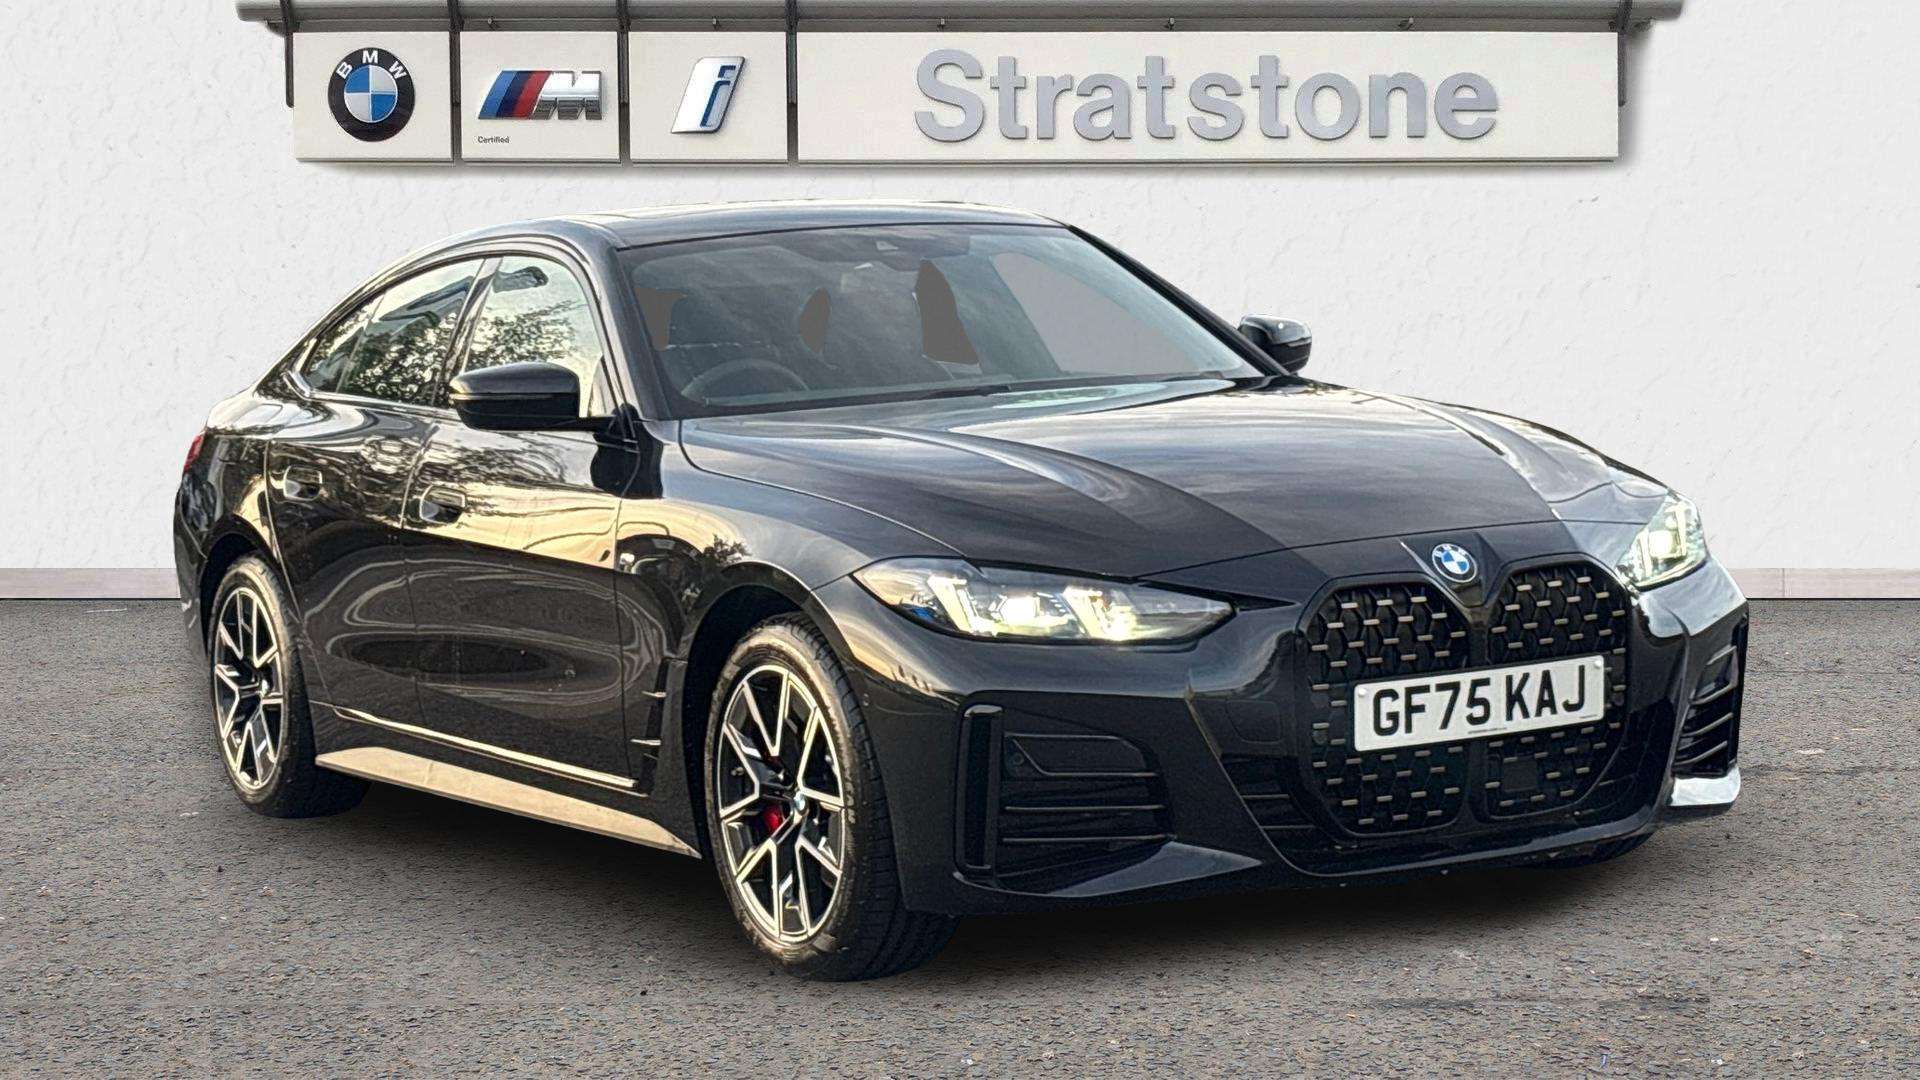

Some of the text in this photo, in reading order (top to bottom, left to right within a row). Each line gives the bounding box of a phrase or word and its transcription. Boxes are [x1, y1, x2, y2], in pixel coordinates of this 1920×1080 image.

[336, 50, 407, 80] BMW
[914, 48, 1500, 143] Stratstone
[477, 136, 510, 144] Certified
[1372, 664, 1586, 737] GF75 KAJ
